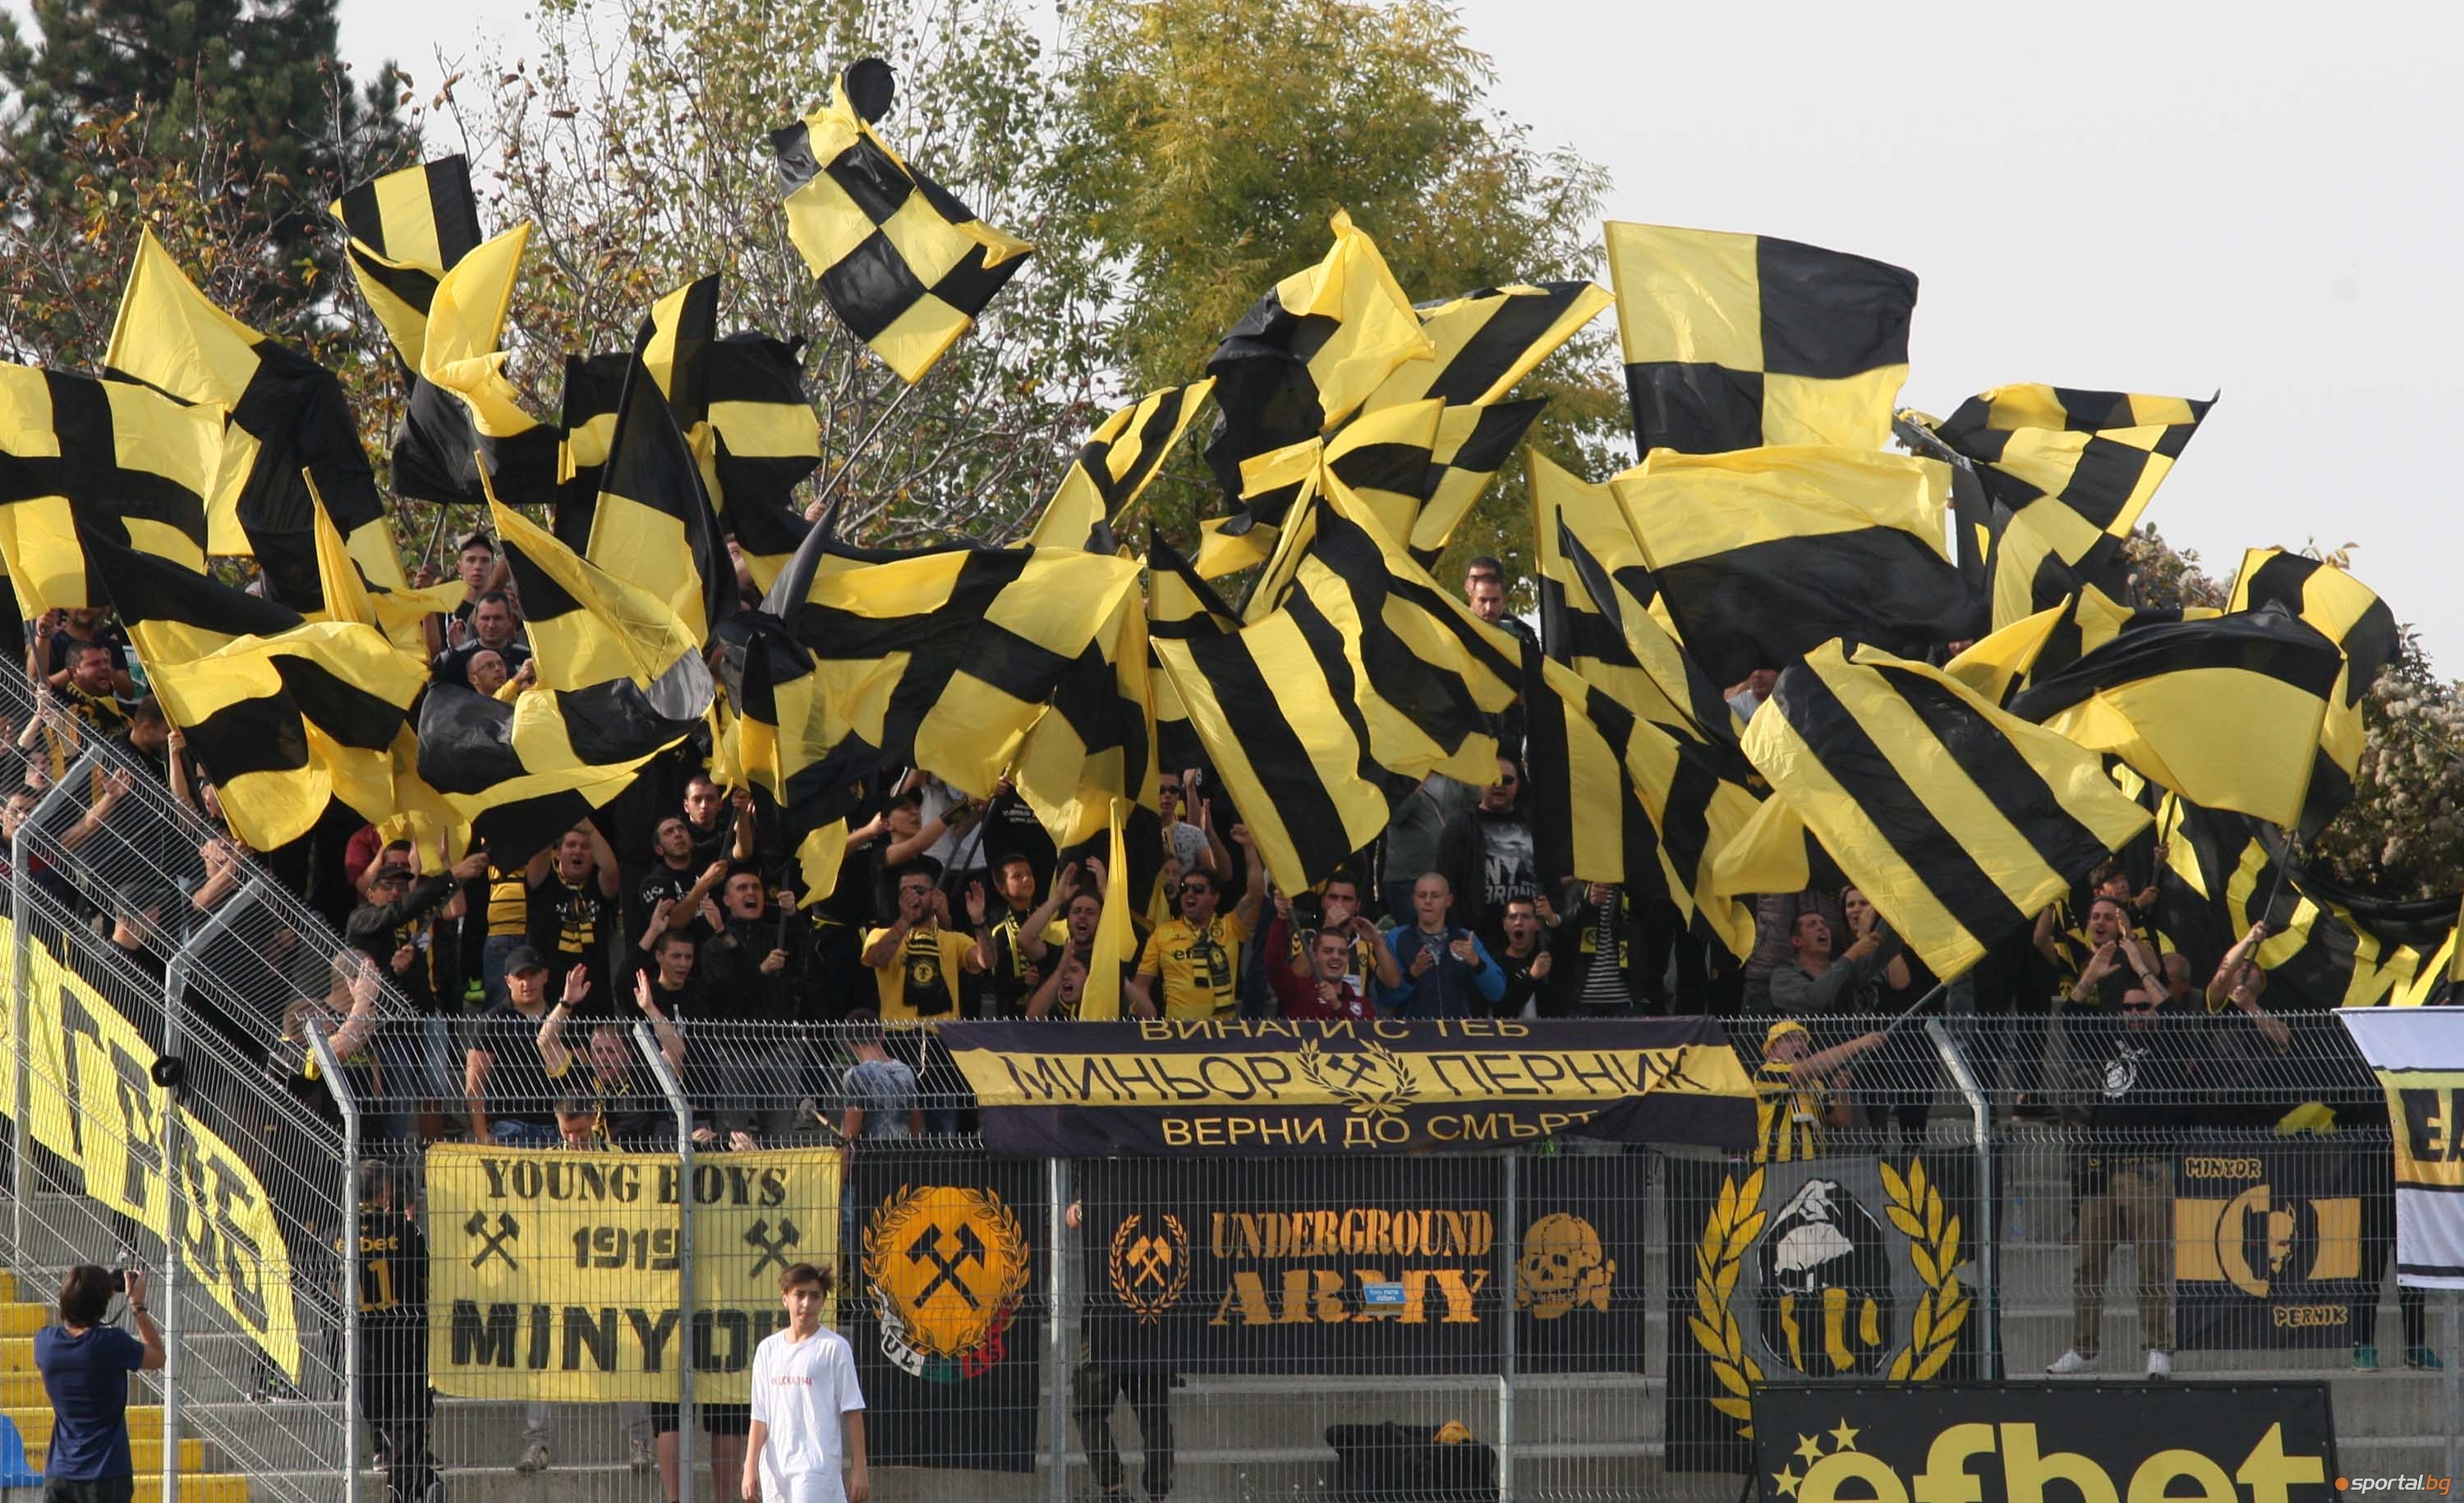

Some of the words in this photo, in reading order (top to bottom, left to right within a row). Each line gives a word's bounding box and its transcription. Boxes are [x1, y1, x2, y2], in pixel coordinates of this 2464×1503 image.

[999, 1056, 1292, 1101] МИНЬОР
[1427, 1046, 1711, 1096] ПЕРНИК
[1161, 1117, 1327, 1146] ВЕРНИ
[1343, 1116, 1411, 1149] ДО
[480, 1158, 641, 1203] YOUNG
[657, 1164, 787, 1207] BOYS
[2185, 1156, 2262, 1179] MINYOR
[335, 1235, 399, 1252] ebet
[572, 1226, 681, 1271] 1919
[1211, 1208, 1493, 1259] UNDERGROUND
[2273, 1305, 2348, 1327] PERNIK
